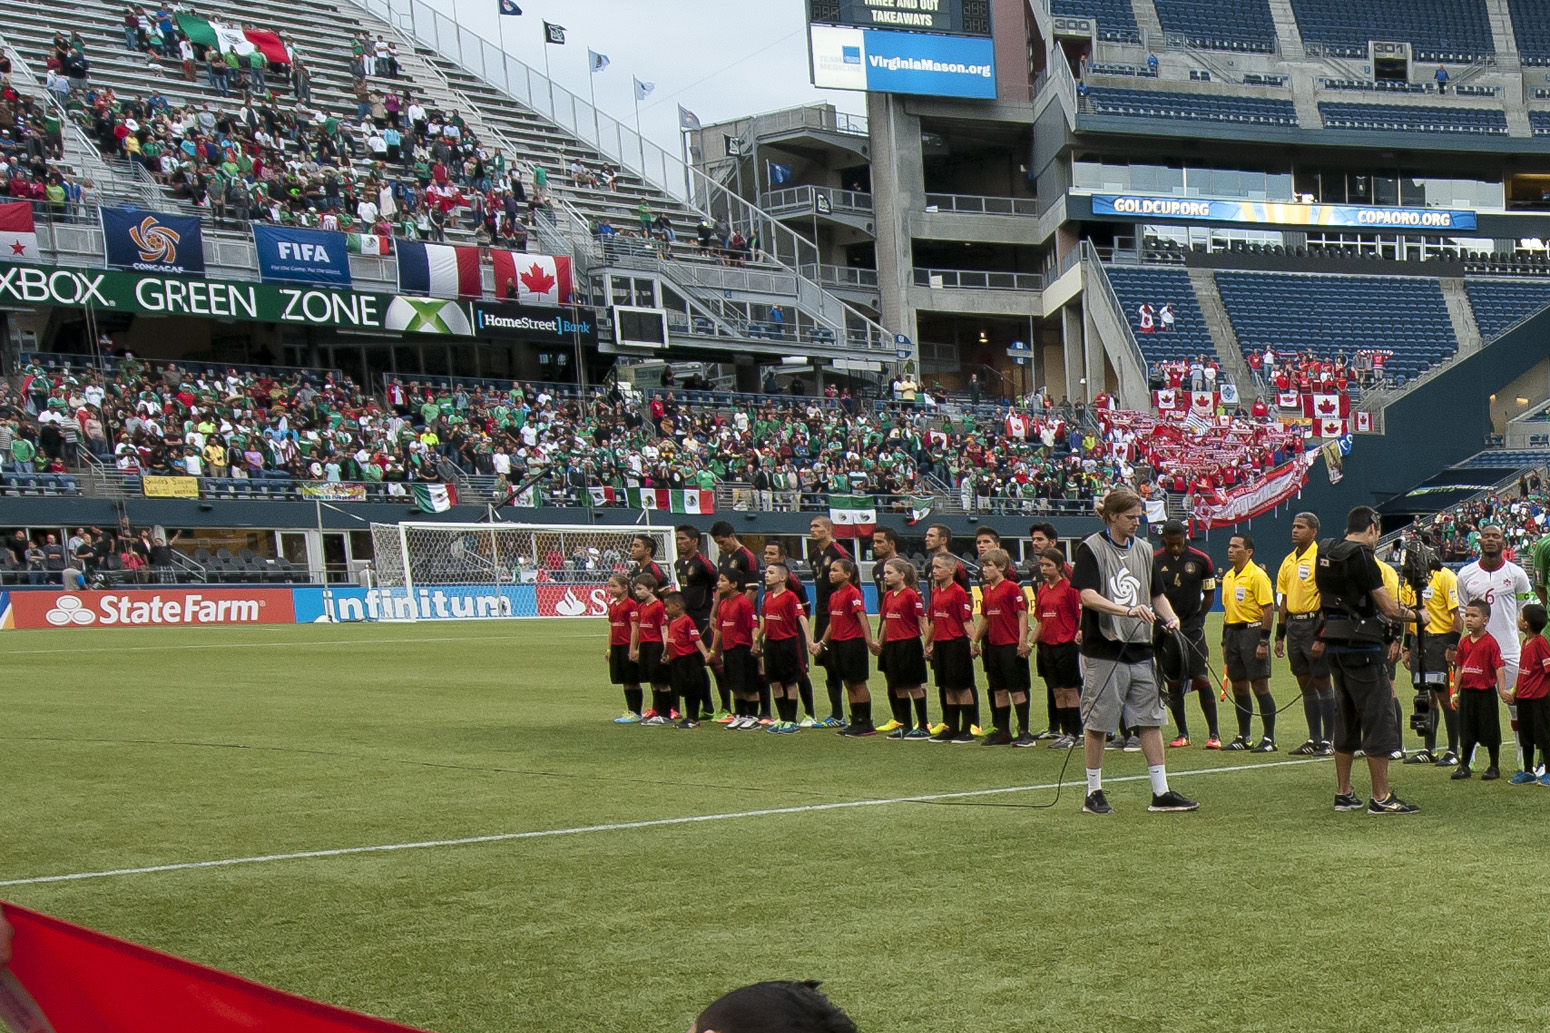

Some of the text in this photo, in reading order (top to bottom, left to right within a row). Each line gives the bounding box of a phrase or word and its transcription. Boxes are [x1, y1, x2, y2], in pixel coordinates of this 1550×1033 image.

[897, 0, 919, 10] AND
[920, 0, 939, 11] OUT
[871, 10, 933, 26] TAKEAWAYS
[1375, 43, 1404, 54] 301
[869, 55, 991, 77] VirginiaMason.org
[1114, 198, 1209, 216] GOLDCUP.ORG
[1358, 210, 1450, 226] COPAORO.ORG
[277, 241, 330, 263] FIFA
[133, 262, 184, 274] CONCACAF
[0, 267, 380, 326] XBOX GREEN ZONE
[563, 320, 587, 333] Bank
[322, 589, 512, 619] infinitum
[1485, 588, 1495, 605] 6
